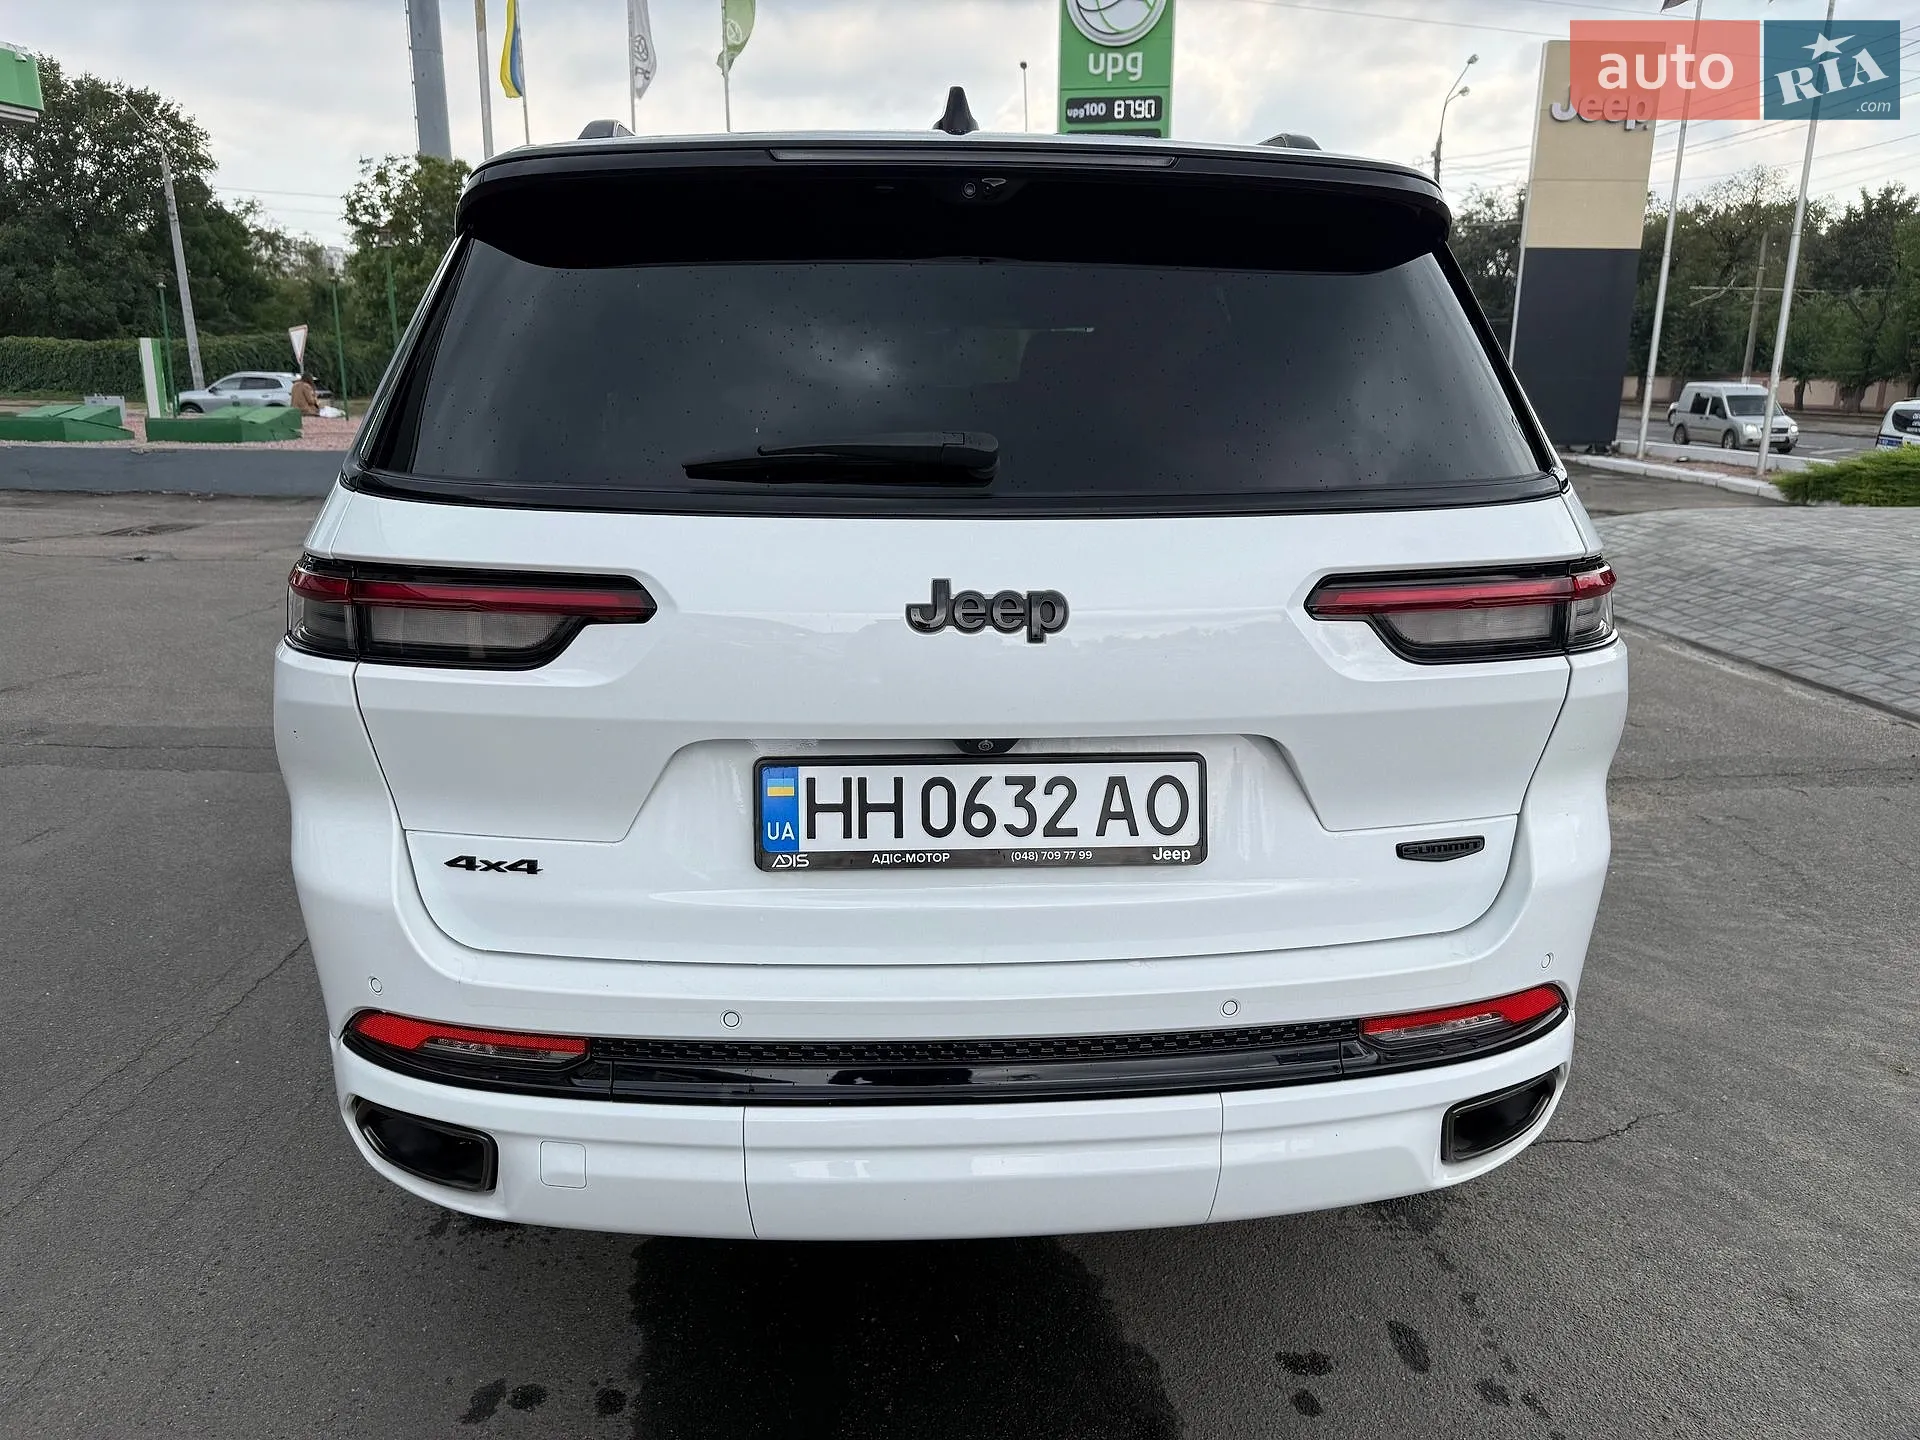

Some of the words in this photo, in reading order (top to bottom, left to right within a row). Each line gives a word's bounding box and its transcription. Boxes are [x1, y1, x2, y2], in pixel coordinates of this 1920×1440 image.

[1088, 51, 1143, 82] upg
[1551, 83, 1654, 130] Jeep
[905, 578, 1069, 643] Jeep
[806, 776, 904, 839] HH
[921, 775, 1078, 838] 0632
[1095, 774, 1190, 837] AO
[767, 821, 796, 841] UA
[871, 853, 950, 864] АДІС-МОТОР
[1010, 851, 1039, 863] (048)
[1041, 850, 1061, 860] 709
[1064, 850, 1076, 860] 77
[1079, 850, 1093, 860] 99
[1152, 847, 1191, 862] Jeep
